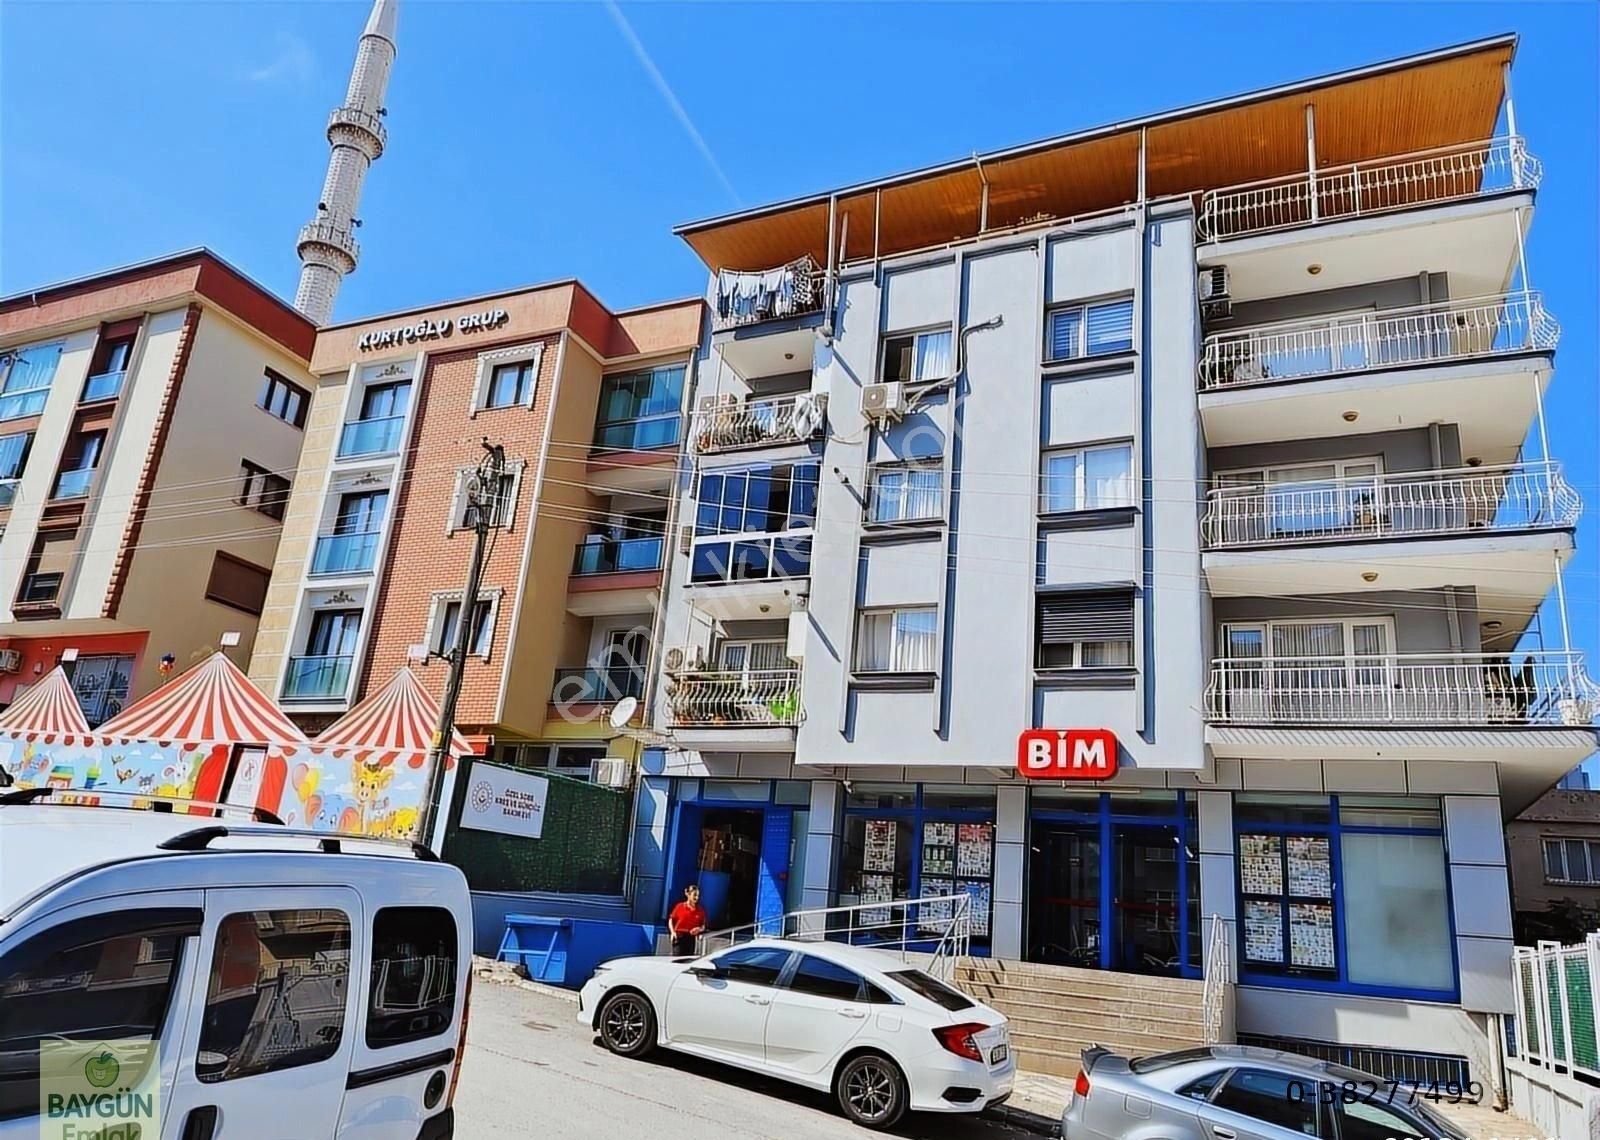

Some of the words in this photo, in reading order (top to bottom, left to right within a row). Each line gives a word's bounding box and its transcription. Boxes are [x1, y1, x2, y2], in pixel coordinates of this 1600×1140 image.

[357, 319, 451, 349] KURTOĞLU
[456, 308, 506, 332] GRUP
[1027, 731, 1106, 768] BİM
